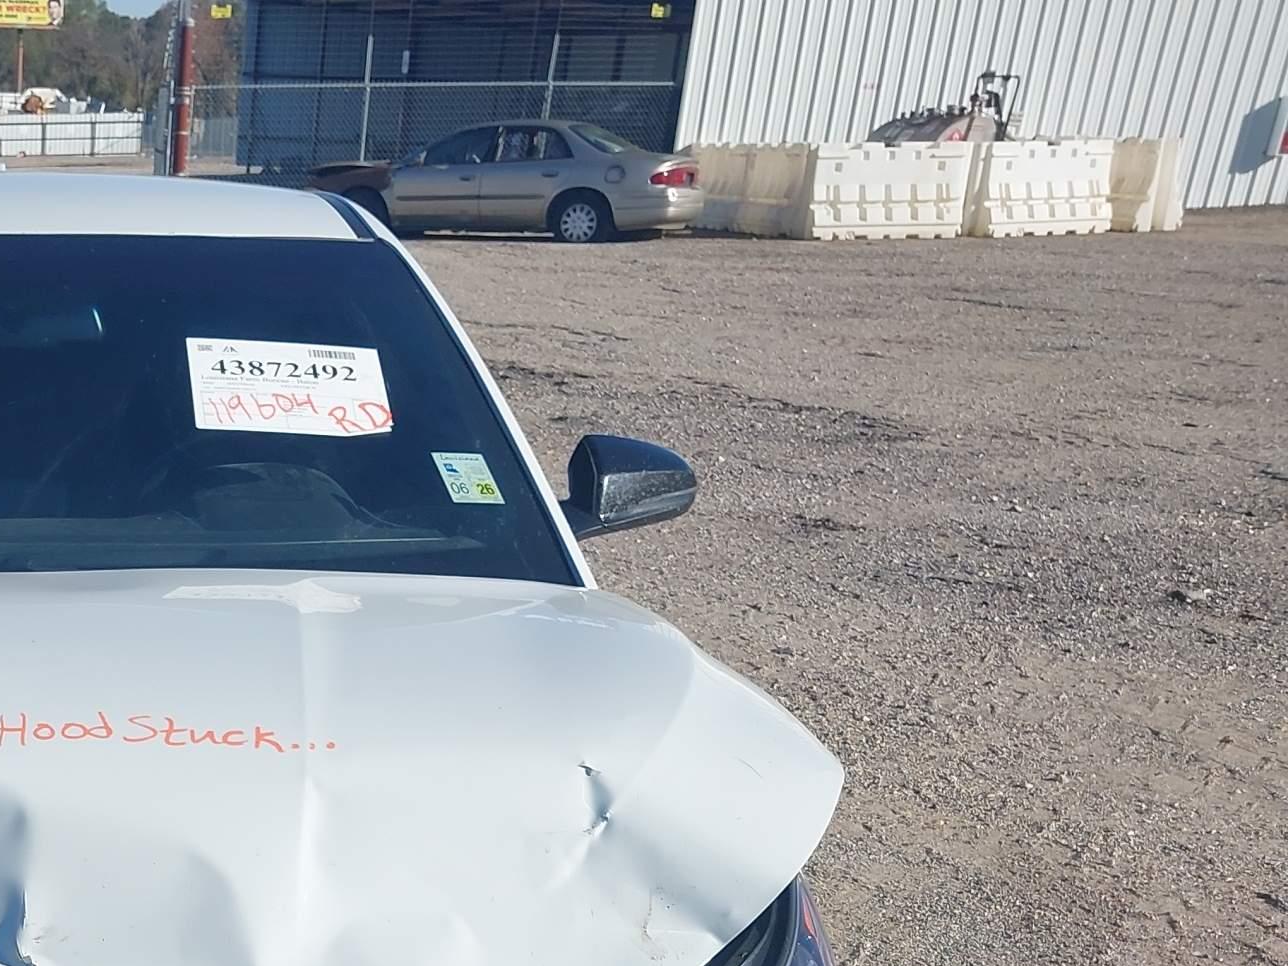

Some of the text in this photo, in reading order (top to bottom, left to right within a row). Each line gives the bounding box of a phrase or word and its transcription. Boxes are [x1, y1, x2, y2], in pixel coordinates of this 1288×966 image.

[6, 5, 46, 13] WRECK?
[211, 359, 357, 382] 43872492
[328, 402, 393, 433] RD
[450, 482, 470, 494] 06
[476, 483, 495, 495] 26
